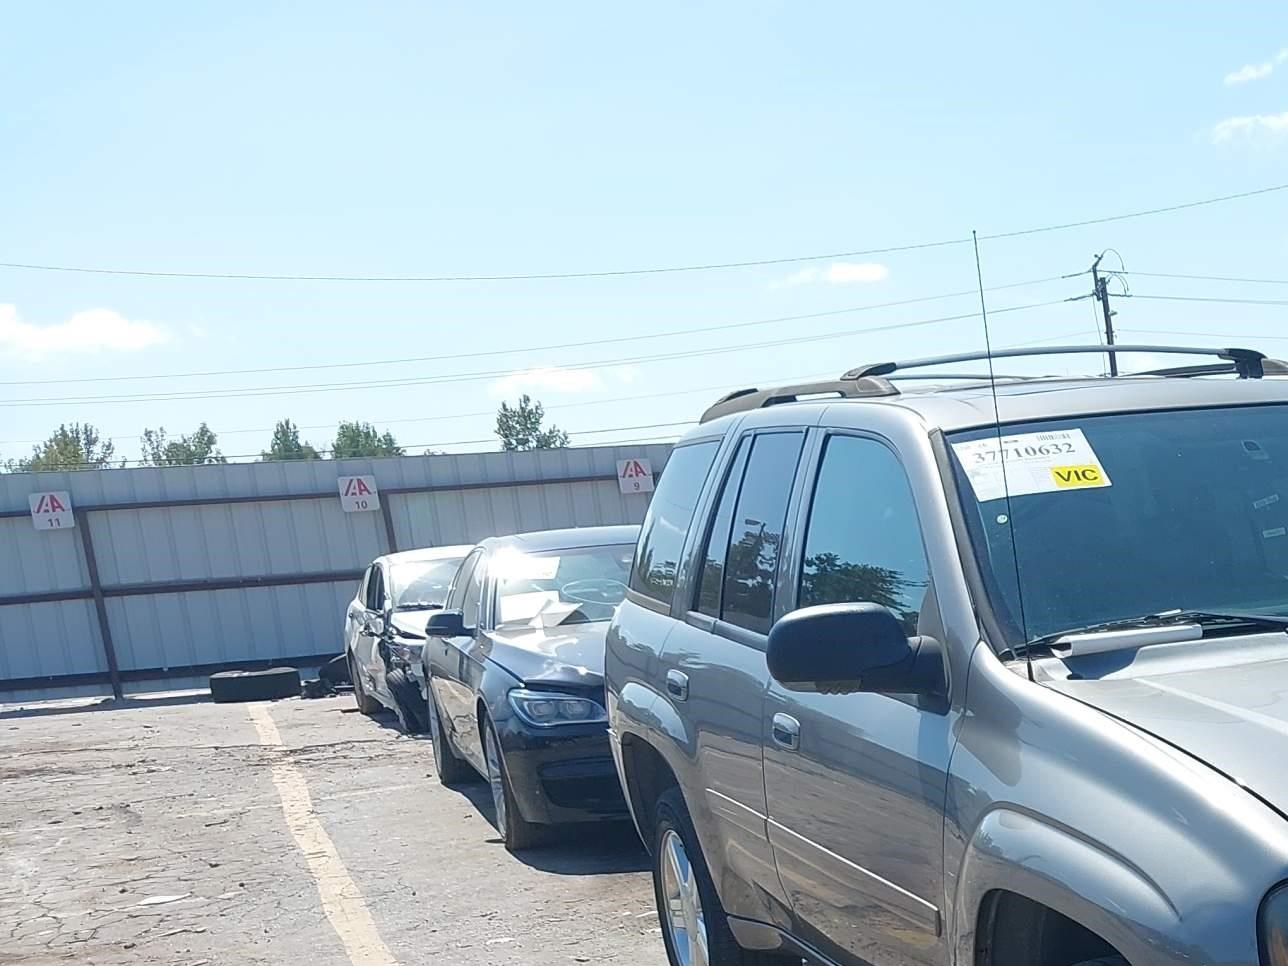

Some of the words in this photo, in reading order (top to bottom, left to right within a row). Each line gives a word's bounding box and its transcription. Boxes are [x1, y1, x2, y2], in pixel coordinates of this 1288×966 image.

[972, 442, 1076, 464] 37710632
[1054, 469, 1099, 483] VIC
[633, 482, 640, 491] 9
[354, 500, 368, 510] 10
[47, 518, 61, 528] 11
